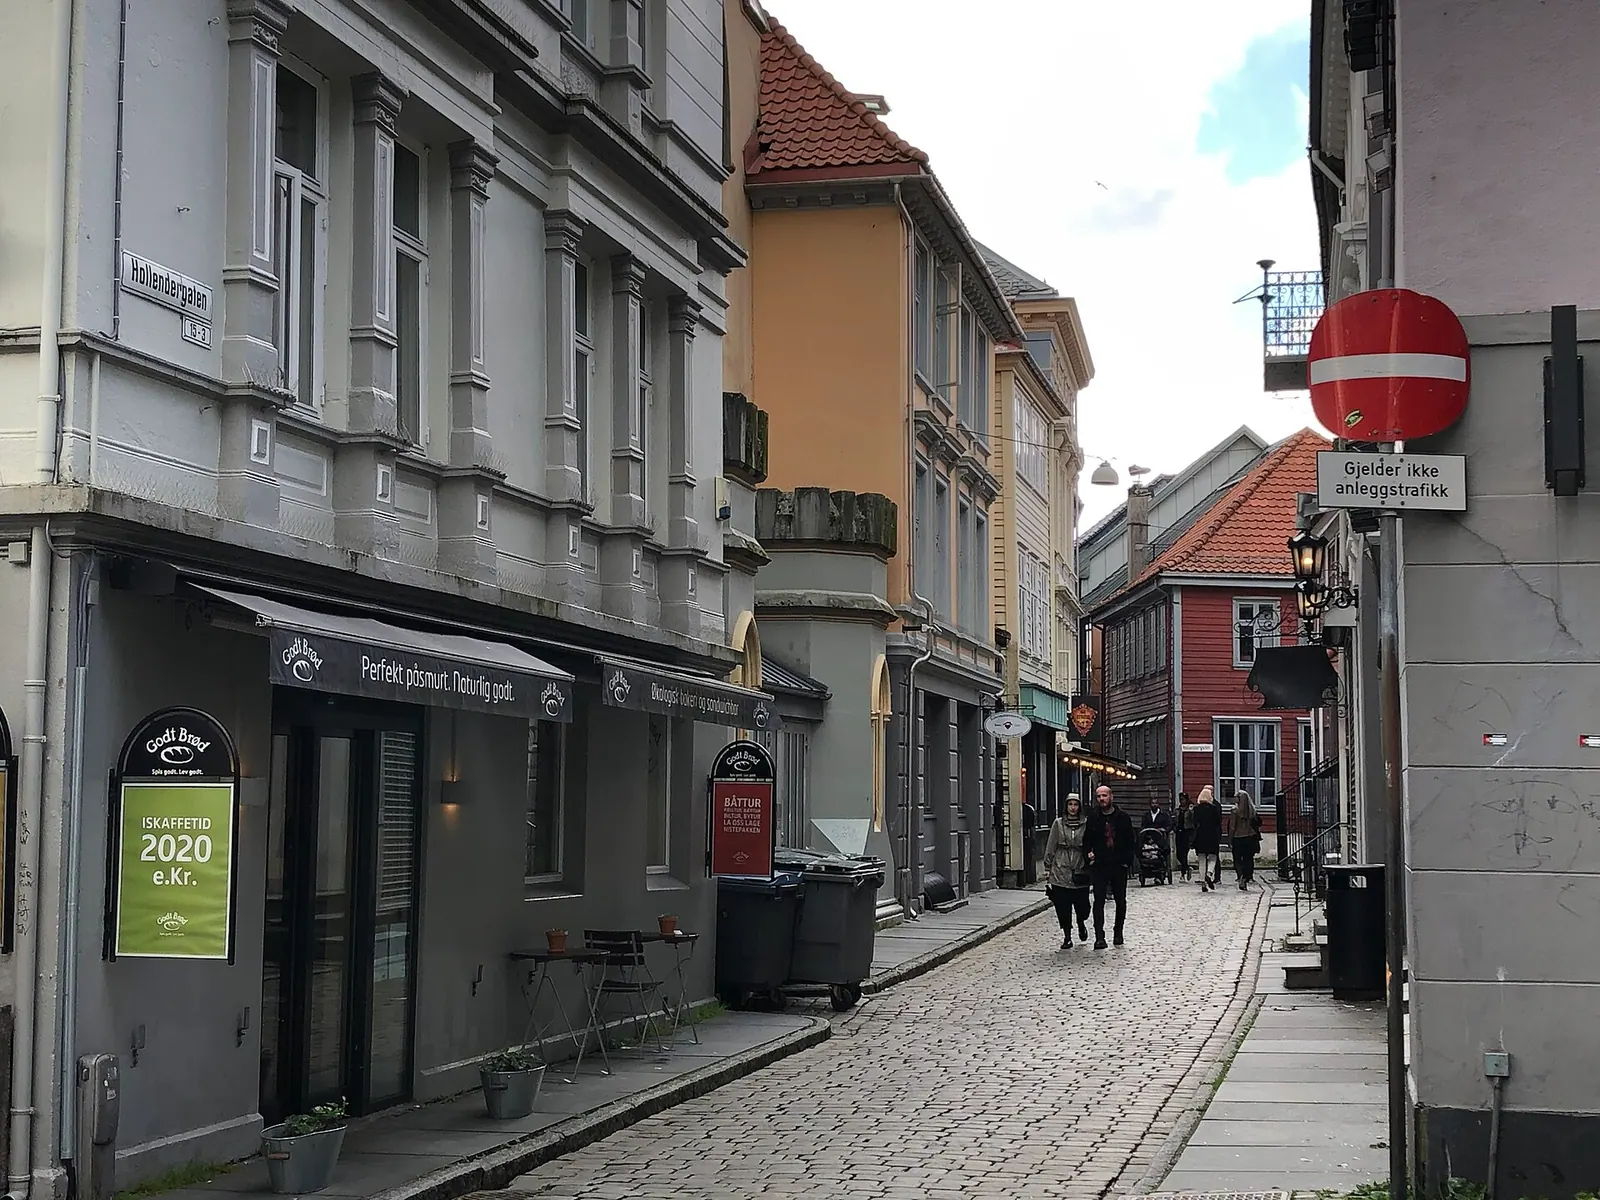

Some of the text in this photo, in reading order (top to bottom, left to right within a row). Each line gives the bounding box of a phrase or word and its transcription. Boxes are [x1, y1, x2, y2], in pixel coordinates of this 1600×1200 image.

[130, 257, 207, 312] Hollendergaten
[1344, 461, 1439, 479] Gjelder ikke
[1335, 481, 1450, 499] anleggstrafikk
[282, 637, 324, 671] Godt Brød
[362, 655, 516, 704] Perfekt påsmurt. Naturlig godt.
[698, 696, 706, 714] og
[146, 727, 211, 753] Godt Brød
[726, 751, 742, 765] Godt
[151, 768, 163, 776] Spis
[724, 794, 761, 808] BÅTTUR
[142, 817, 211, 830] ISKAFFETID
[141, 833, 212, 863] 2020
[153, 866, 197, 886] e.Kr.
[157, 912, 172, 925] Godt
